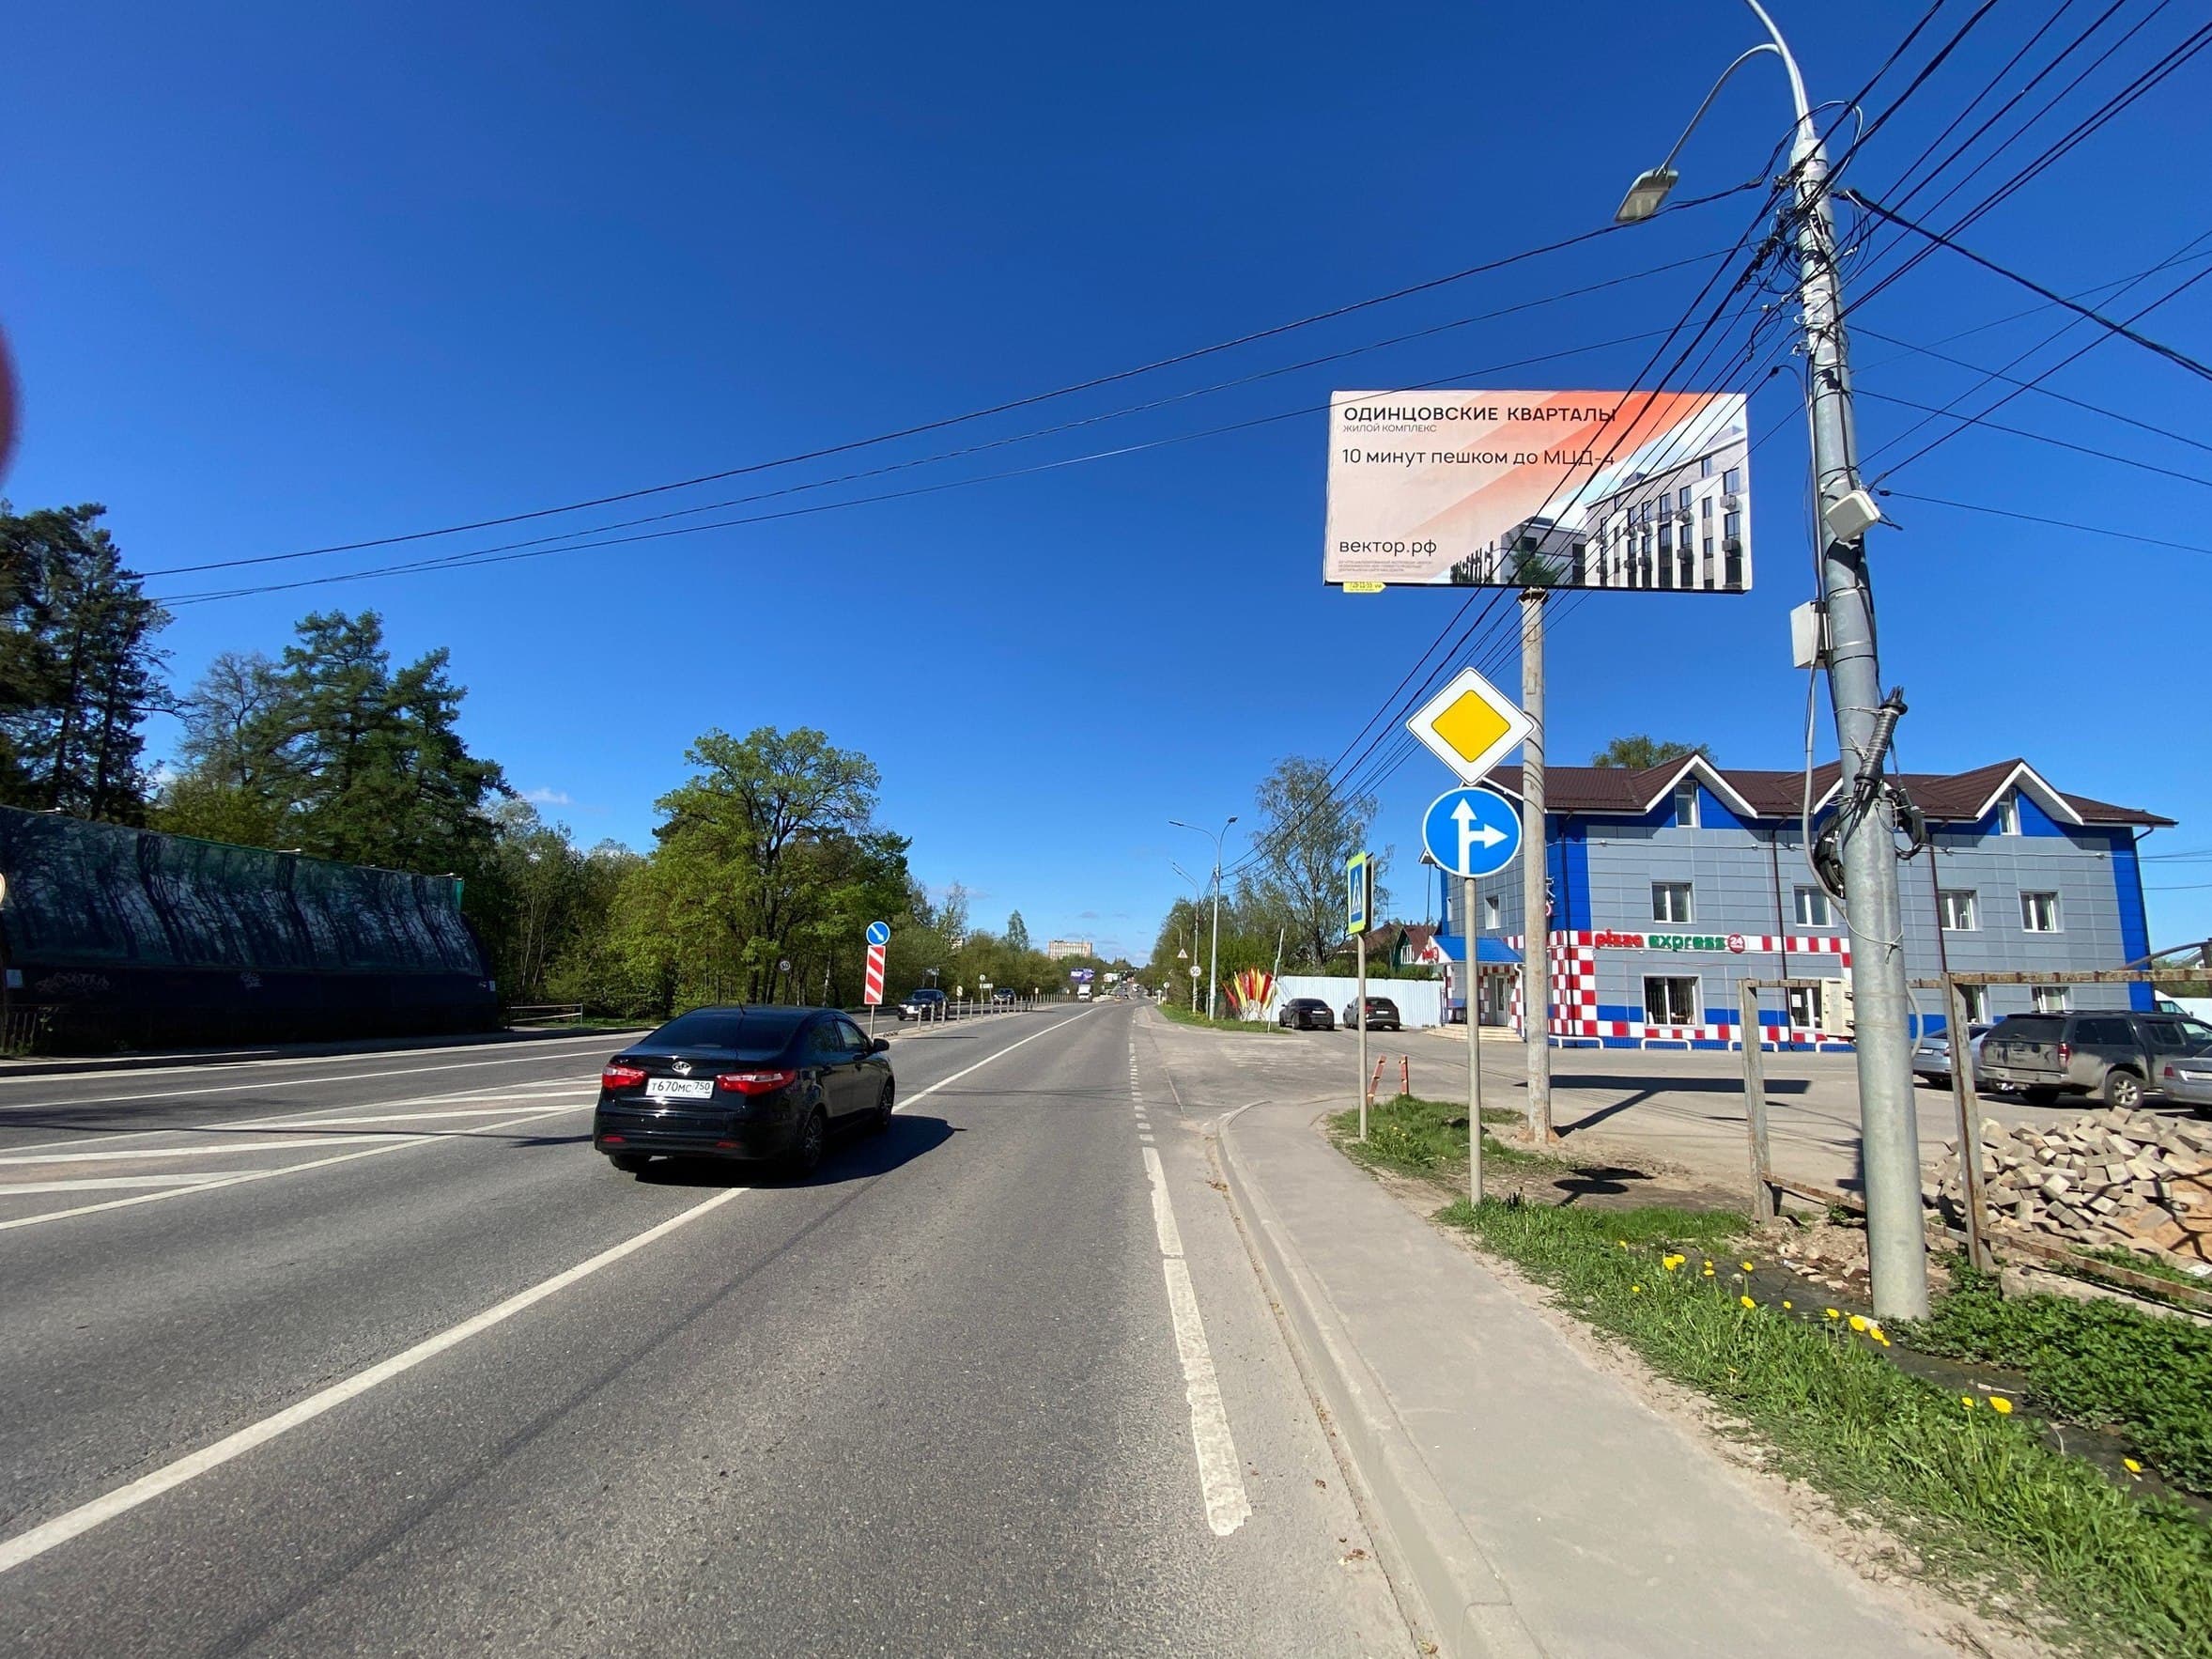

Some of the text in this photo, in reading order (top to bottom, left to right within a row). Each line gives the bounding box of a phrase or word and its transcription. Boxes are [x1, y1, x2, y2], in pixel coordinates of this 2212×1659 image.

[1344, 407, 1616, 422] ОДИНЦОВСКИЕ КВАРТАЛЫ
[1343, 423, 1437, 433] ЖИЛОЙ КОМПЛЕКС
[1342, 448, 1361, 463] 10
[1367, 452, 1426, 468] минут
[1431, 452, 1508, 464] пешком
[1513, 453, 1539, 465] до
[1339, 538, 1437, 557] вектор.рф
[1648, 934, 1725, 953] express
[694, 1081, 711, 1091] 750
